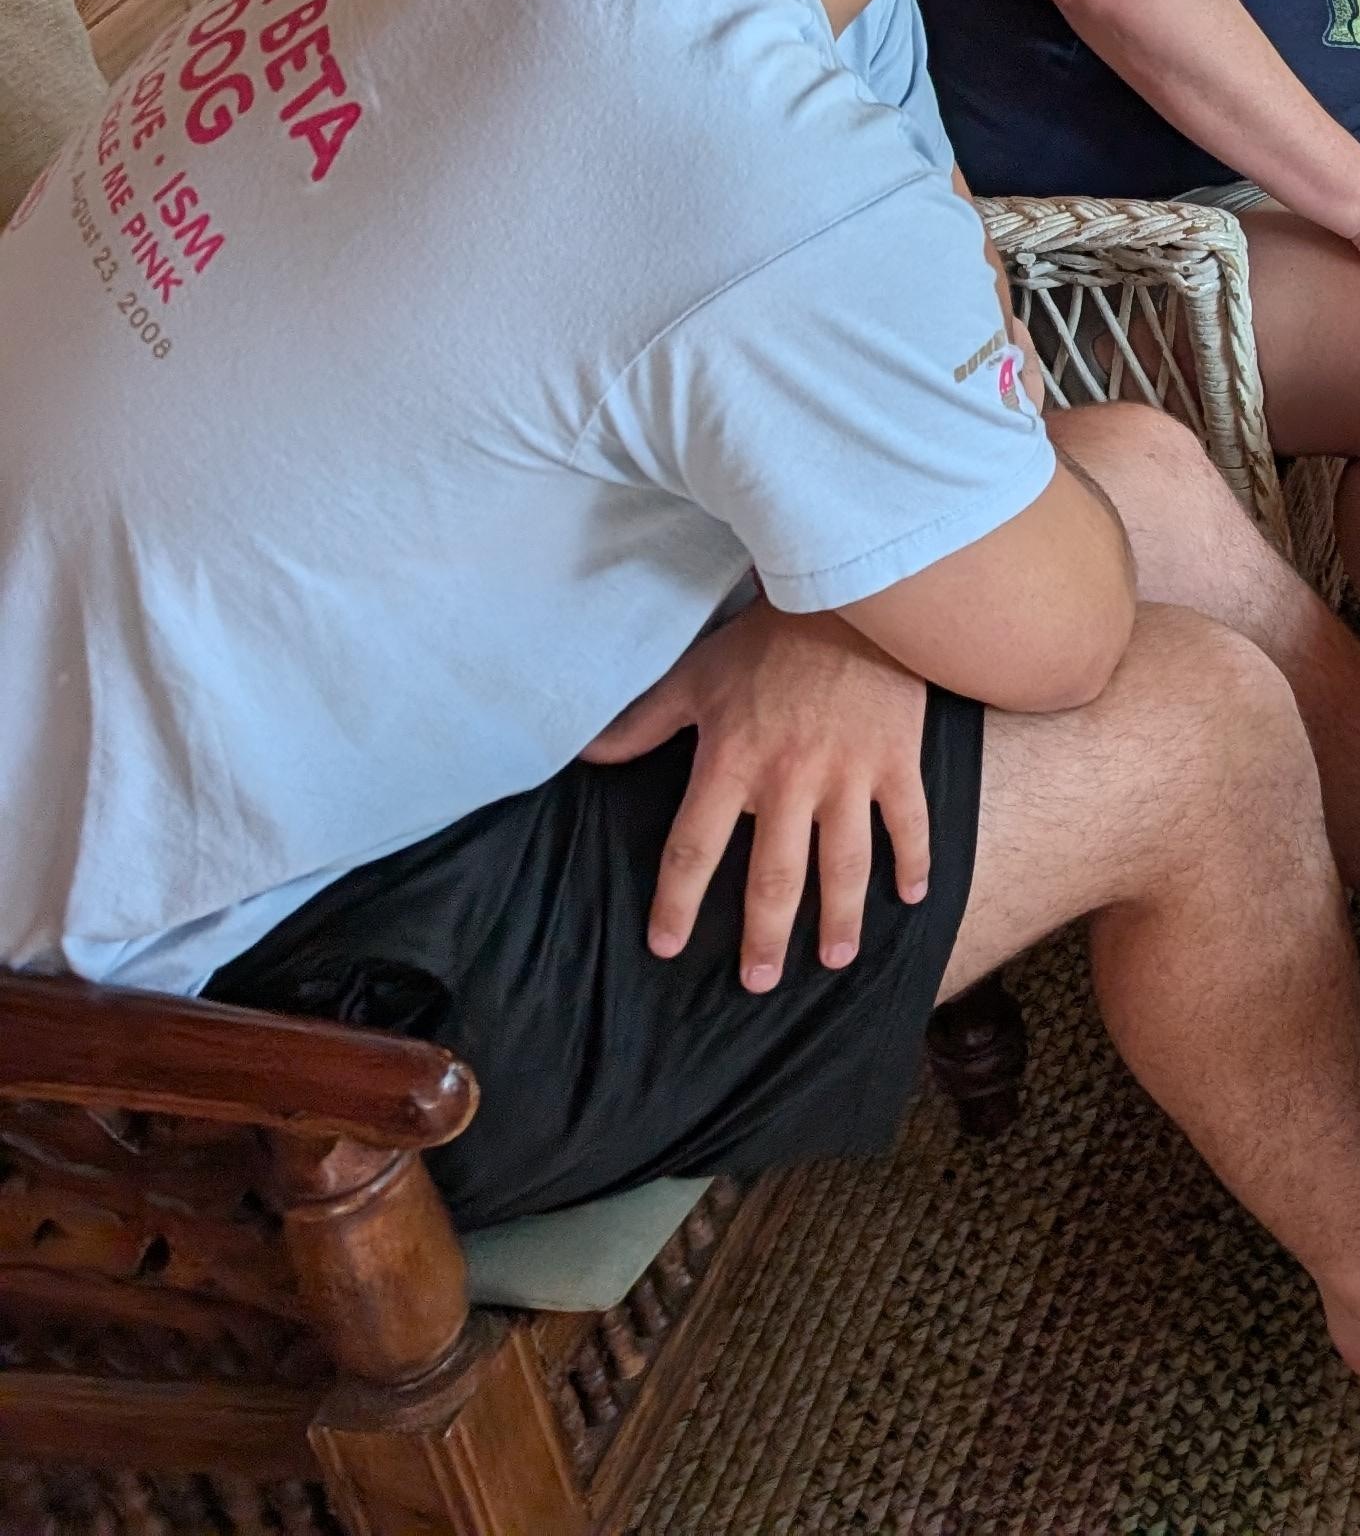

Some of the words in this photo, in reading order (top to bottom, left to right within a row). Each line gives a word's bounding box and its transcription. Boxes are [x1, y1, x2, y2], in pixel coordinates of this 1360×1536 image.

[101, 162, 135, 215] ME
[121, 212, 184, 305] PINK
[152, 171, 225, 274] ISM
[117, 291, 172, 359] 2008
